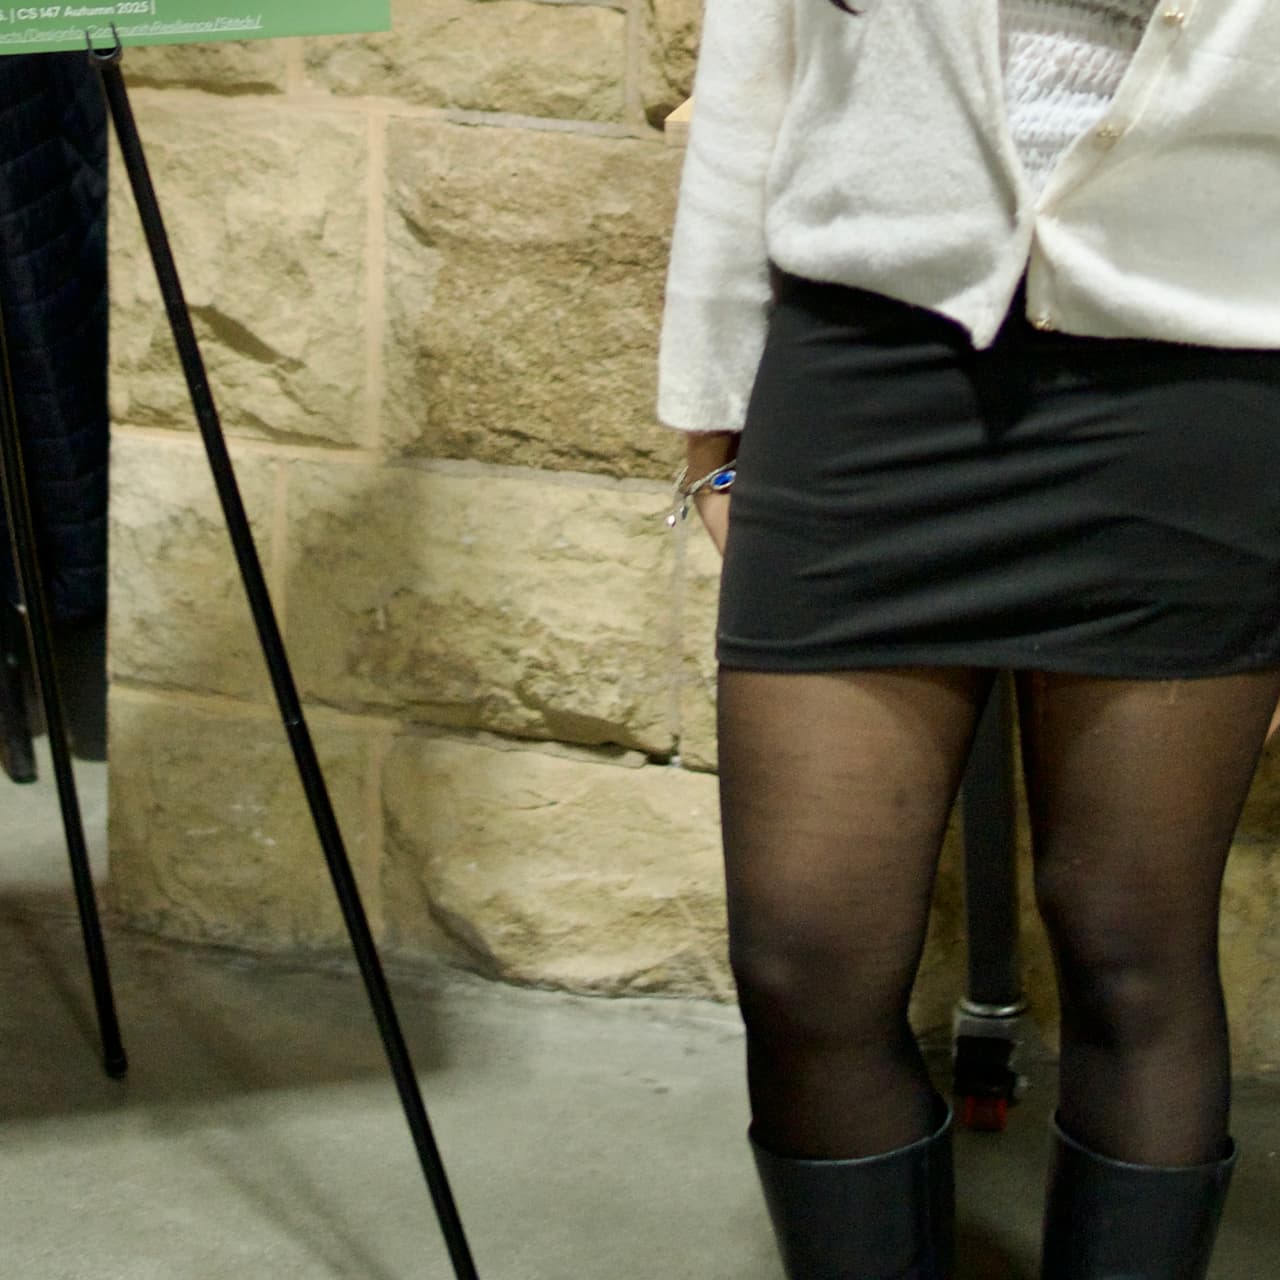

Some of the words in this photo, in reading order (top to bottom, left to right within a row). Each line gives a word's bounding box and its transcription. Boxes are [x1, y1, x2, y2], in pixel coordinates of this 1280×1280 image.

[17, 8, 38, 20] CS
[40, 6, 61, 19] 147
[64, 5, 115, 18] Autumn
[116, 1, 150, 14] 2025
